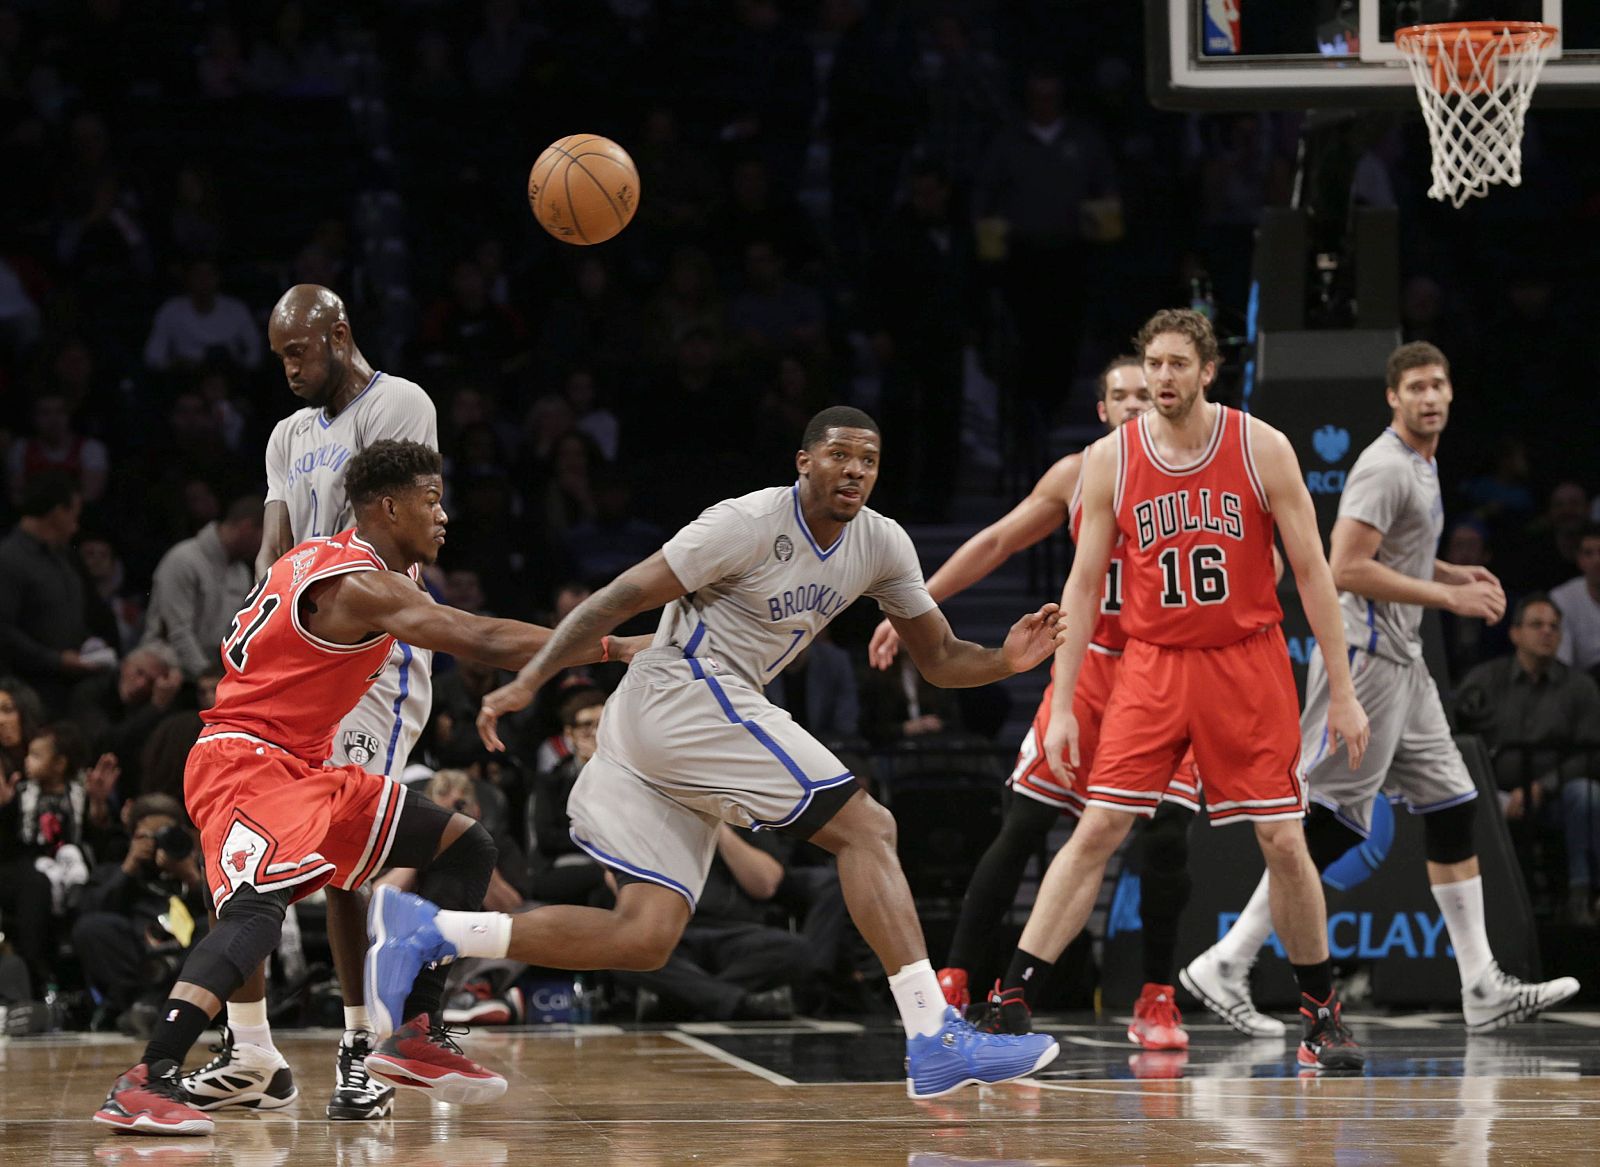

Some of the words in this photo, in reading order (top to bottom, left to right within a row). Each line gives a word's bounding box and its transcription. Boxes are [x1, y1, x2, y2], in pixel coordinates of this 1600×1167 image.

[1133, 488, 1244, 552] BULLS
[1158, 545, 1230, 608] 16
[766, 629, 806, 672] 7
[344, 731, 379, 754] NETS
